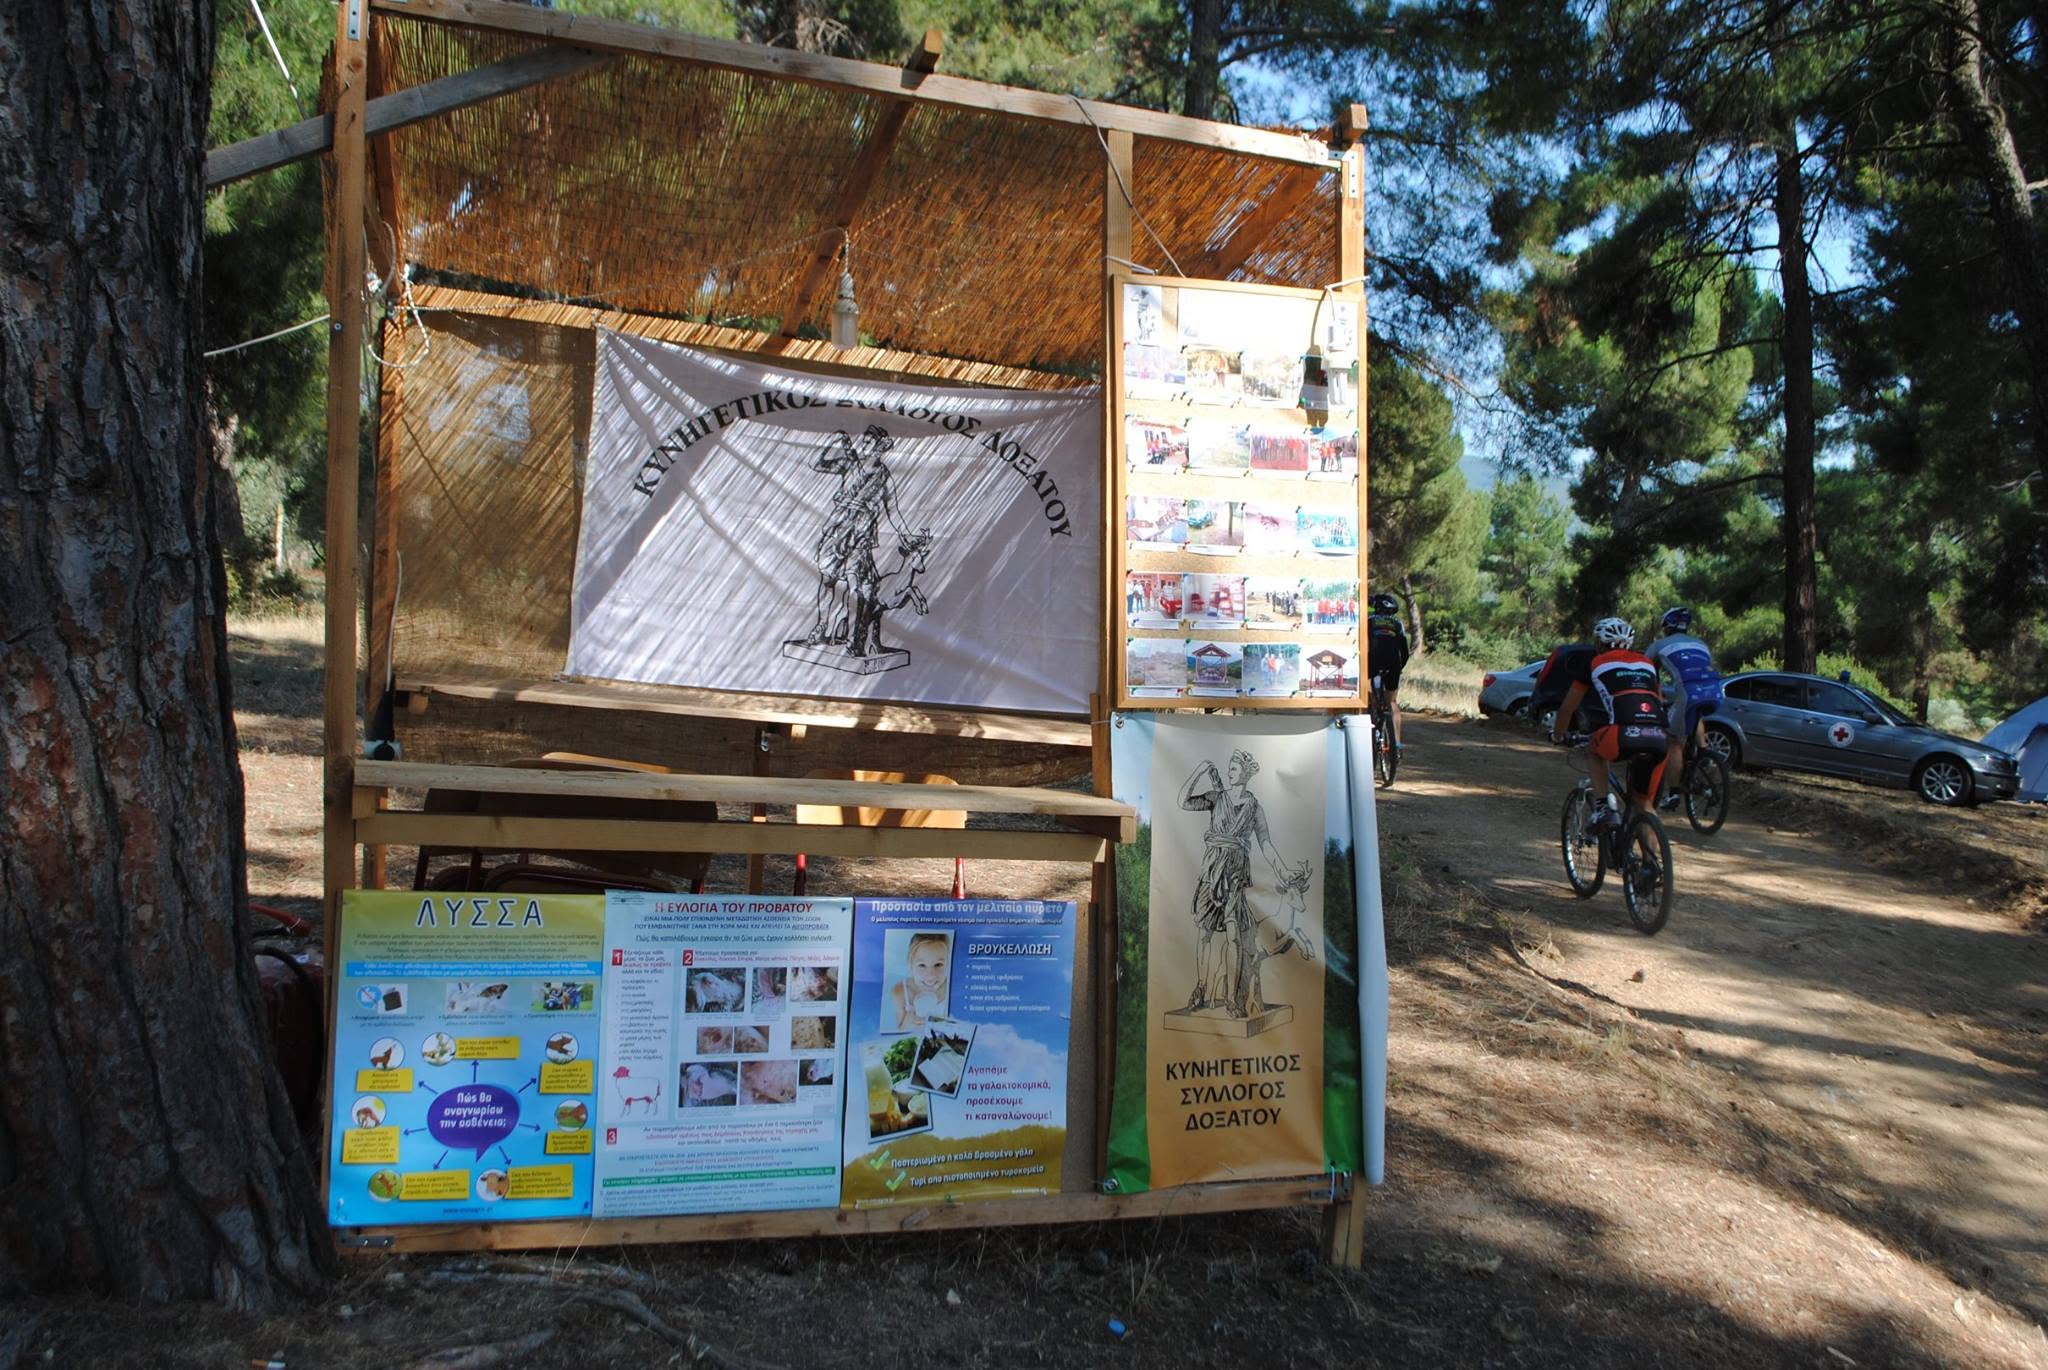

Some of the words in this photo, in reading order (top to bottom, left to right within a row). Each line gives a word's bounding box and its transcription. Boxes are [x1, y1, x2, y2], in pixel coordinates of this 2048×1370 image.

[981, 431, 1072, 537] ΔΟΞΑΤΟΥ
[416, 898, 543, 927] ΛΥΣΣΑ
[655, 902, 664, 913] Η
[668, 902, 718, 913] ΕΥΛΟΓΙΑ
[722, 902, 745, 913] ΤΟΥ
[748, 903, 813, 913] ΠΡΟΒΑΤΟΥ
[872, 901, 931, 913] Προστασία
[934, 901, 954, 912] από
[957, 904, 974, 912] τον
[977, 902, 1022, 914] μελιταίο
[1025, 902, 1063, 914] πυρετό
[968, 943, 1050, 954] ΒΡΟΥΚΕΛΛΩΣΗ
[968, 1065, 1008, 1076] Αγαπάμε
[1166, 1054, 1301, 1081] ΚΥΝΗΓΕΤΙΚΟΣ
[457, 1092, 477, 1103] Πώς
[479, 1092, 492, 1103] θα
[1180, 1081, 1286, 1106] ΣΥΛΛΟΓΟΣ
[966, 1096, 1023, 1107] προσέχουμε
[444, 1104, 504, 1118] αναγνωρίσω
[440, 1119, 457, 1128] την
[1185, 1108, 1282, 1131] ΔΟΞΑΤΟΥ
